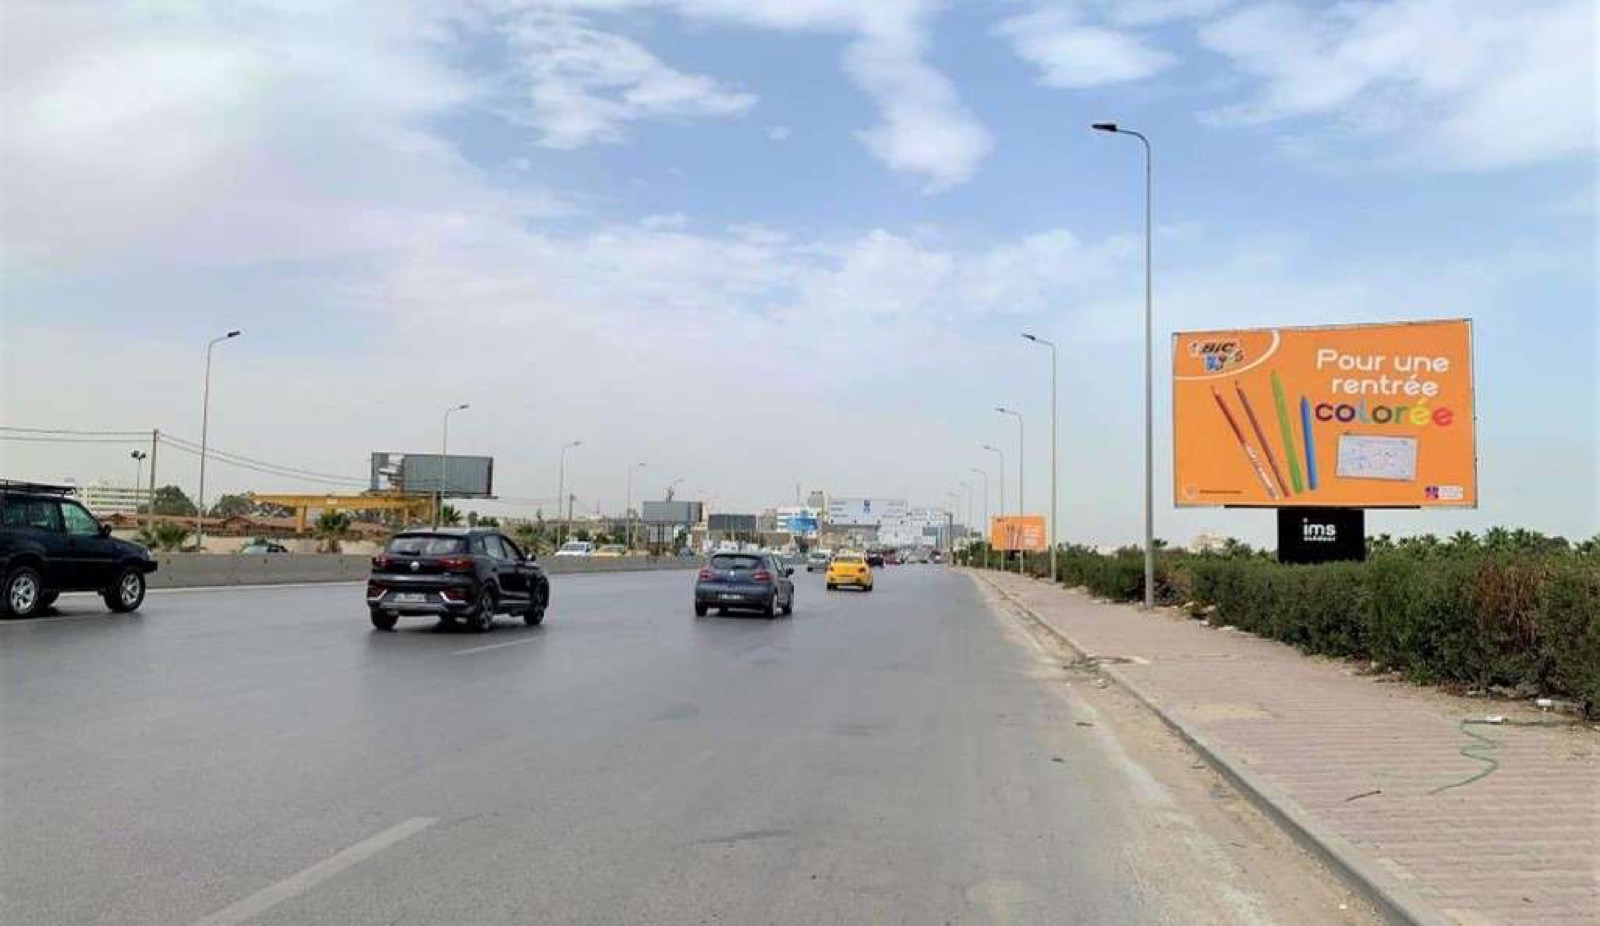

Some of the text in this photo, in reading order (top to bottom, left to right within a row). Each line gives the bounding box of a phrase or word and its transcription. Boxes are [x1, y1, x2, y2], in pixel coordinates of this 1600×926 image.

[1317, 349, 1448, 372] Pour une
[1331, 374, 1439, 396] rentrée
[1315, 398, 1453, 427] colorée
[1303, 517, 1336, 536] ims
